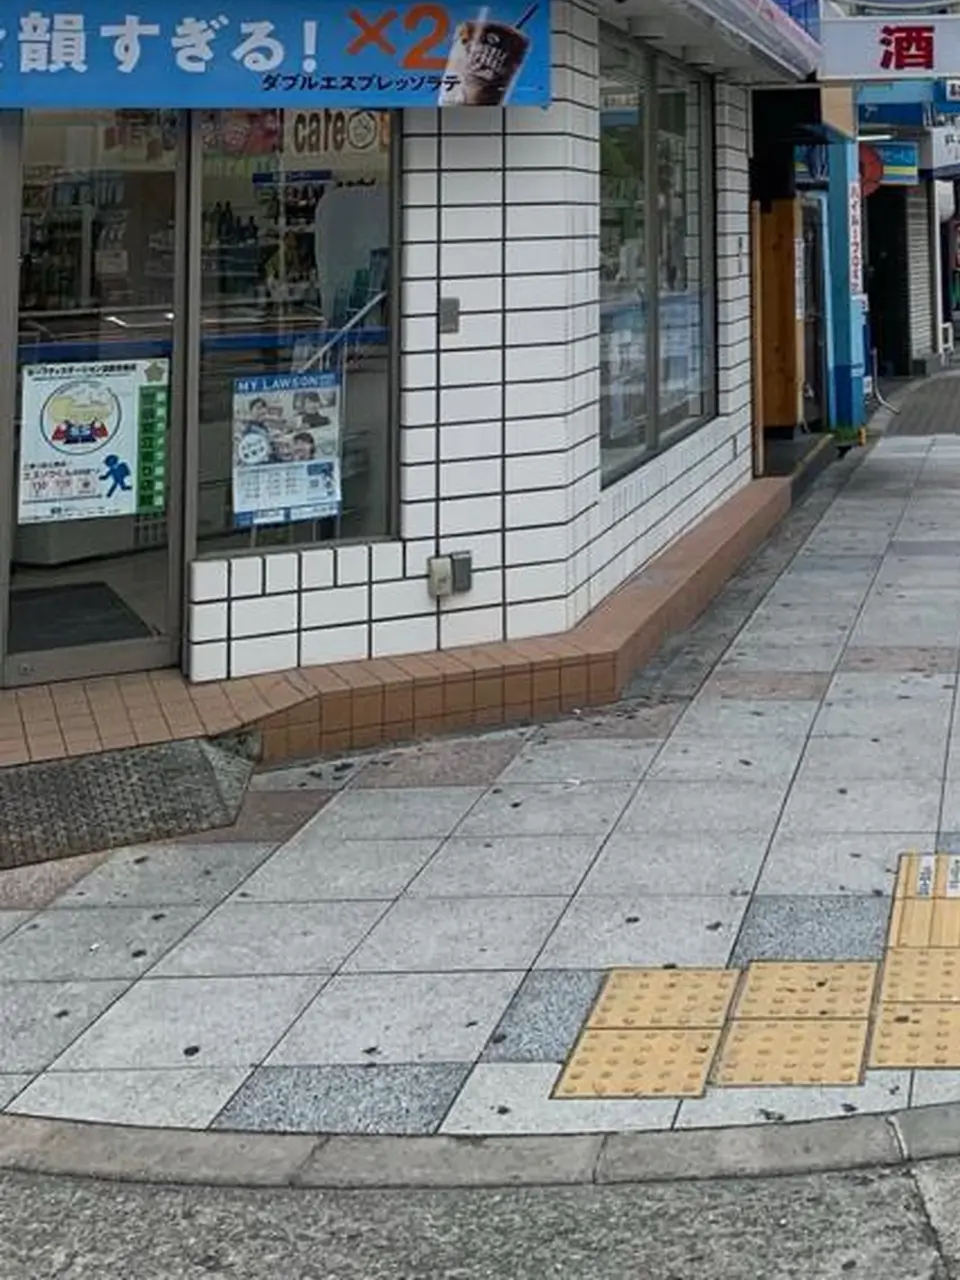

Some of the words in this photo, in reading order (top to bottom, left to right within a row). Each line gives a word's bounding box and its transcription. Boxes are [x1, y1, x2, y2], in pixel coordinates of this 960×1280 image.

[0, 11, 317, 73] 韻すぎる!
[879, 25, 935, 70] 酒
[262, 73, 461, 92] ダブルエスプレッソラテ
[238, 379, 256, 391] MY
[263, 375, 318, 390] LAWSON
